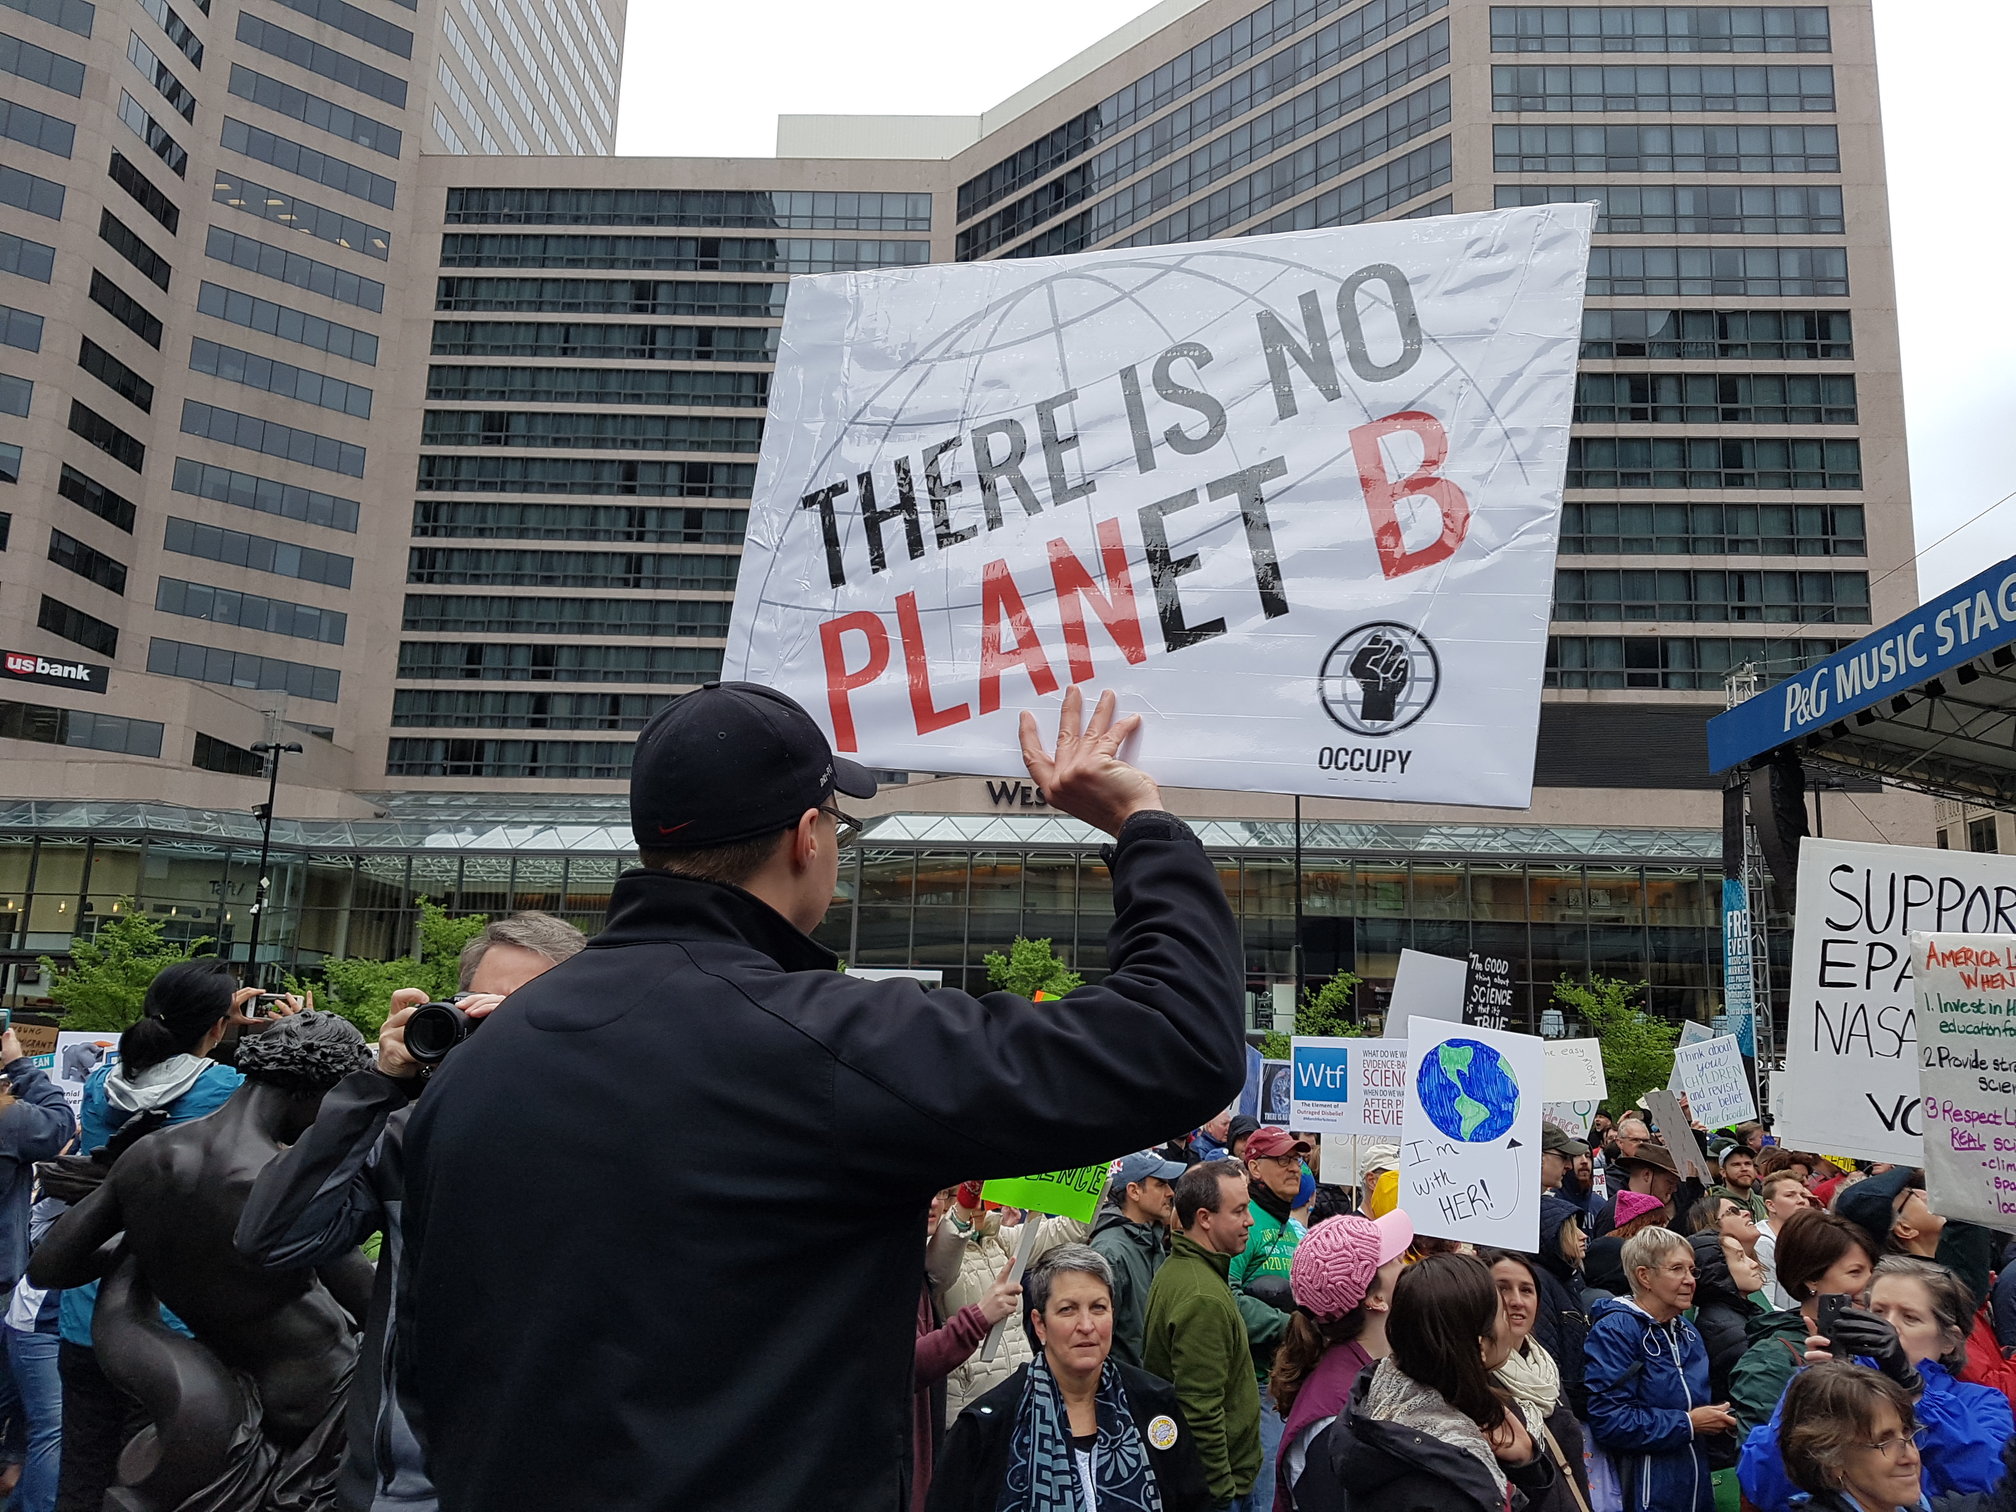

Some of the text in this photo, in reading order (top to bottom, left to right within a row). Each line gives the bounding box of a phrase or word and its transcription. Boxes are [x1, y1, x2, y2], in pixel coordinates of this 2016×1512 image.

[802, 262, 1423, 588] THERE IS NO
[819, 410, 1471, 754] PLANET B
[1783, 667, 1829, 733] P&G
[1835, 623, 1928, 704] MUSIC
[1318, 746, 1412, 774] OCCUPY
[1484, 957, 1509, 975] GOOD
[1926, 941, 2001, 970] AMERICA
[1475, 972, 1509, 987] thing about
[1959, 966, 2016, 992] WHEN
[1471, 984, 1513, 1006] SCIENCE
[1937, 993, 1987, 1014] Invest
[1988, 999, 2003, 1015] in
[1466, 1001, 1474, 1014] is
[1478, 1004, 1490, 1015] that
[1474, 1015, 1509, 1031] TRUE
[1939, 1018, 2001, 1038] education
[1363, 1050, 1379, 1058] WHAT
[1380, 1050, 1389, 1058] DO
[1390, 1051, 1399, 1059] WE
[1679, 1039, 1733, 1064] Think about
[1937, 1046, 1989, 1071] Provide
[1298, 1062, 1346, 1088] Wtf
[1362, 1060, 1408, 1070] EVIDENCE-BA
[1561, 1047, 1585, 1057] easy
[1582, 1058, 1598, 1086] money
[1684, 1064, 1743, 1089] CHILDREN
[1696, 1055, 1729, 1078] your
[1363, 1089, 1379, 1097] WHEN
[1689, 1079, 1739, 1102] and revisit
[1363, 1098, 1394, 1109] AFTER
[1692, 1091, 1744, 1118] your belief
[1721, 1102, 1753, 1122] Goodall
[1942, 1099, 2003, 1128] Respect
[1363, 1108, 1403, 1126] REVIE
[1950, 1126, 1986, 1149] REAL
[1405, 1139, 1460, 1167] I'm
[1439, 1179, 1494, 1226] HER!
